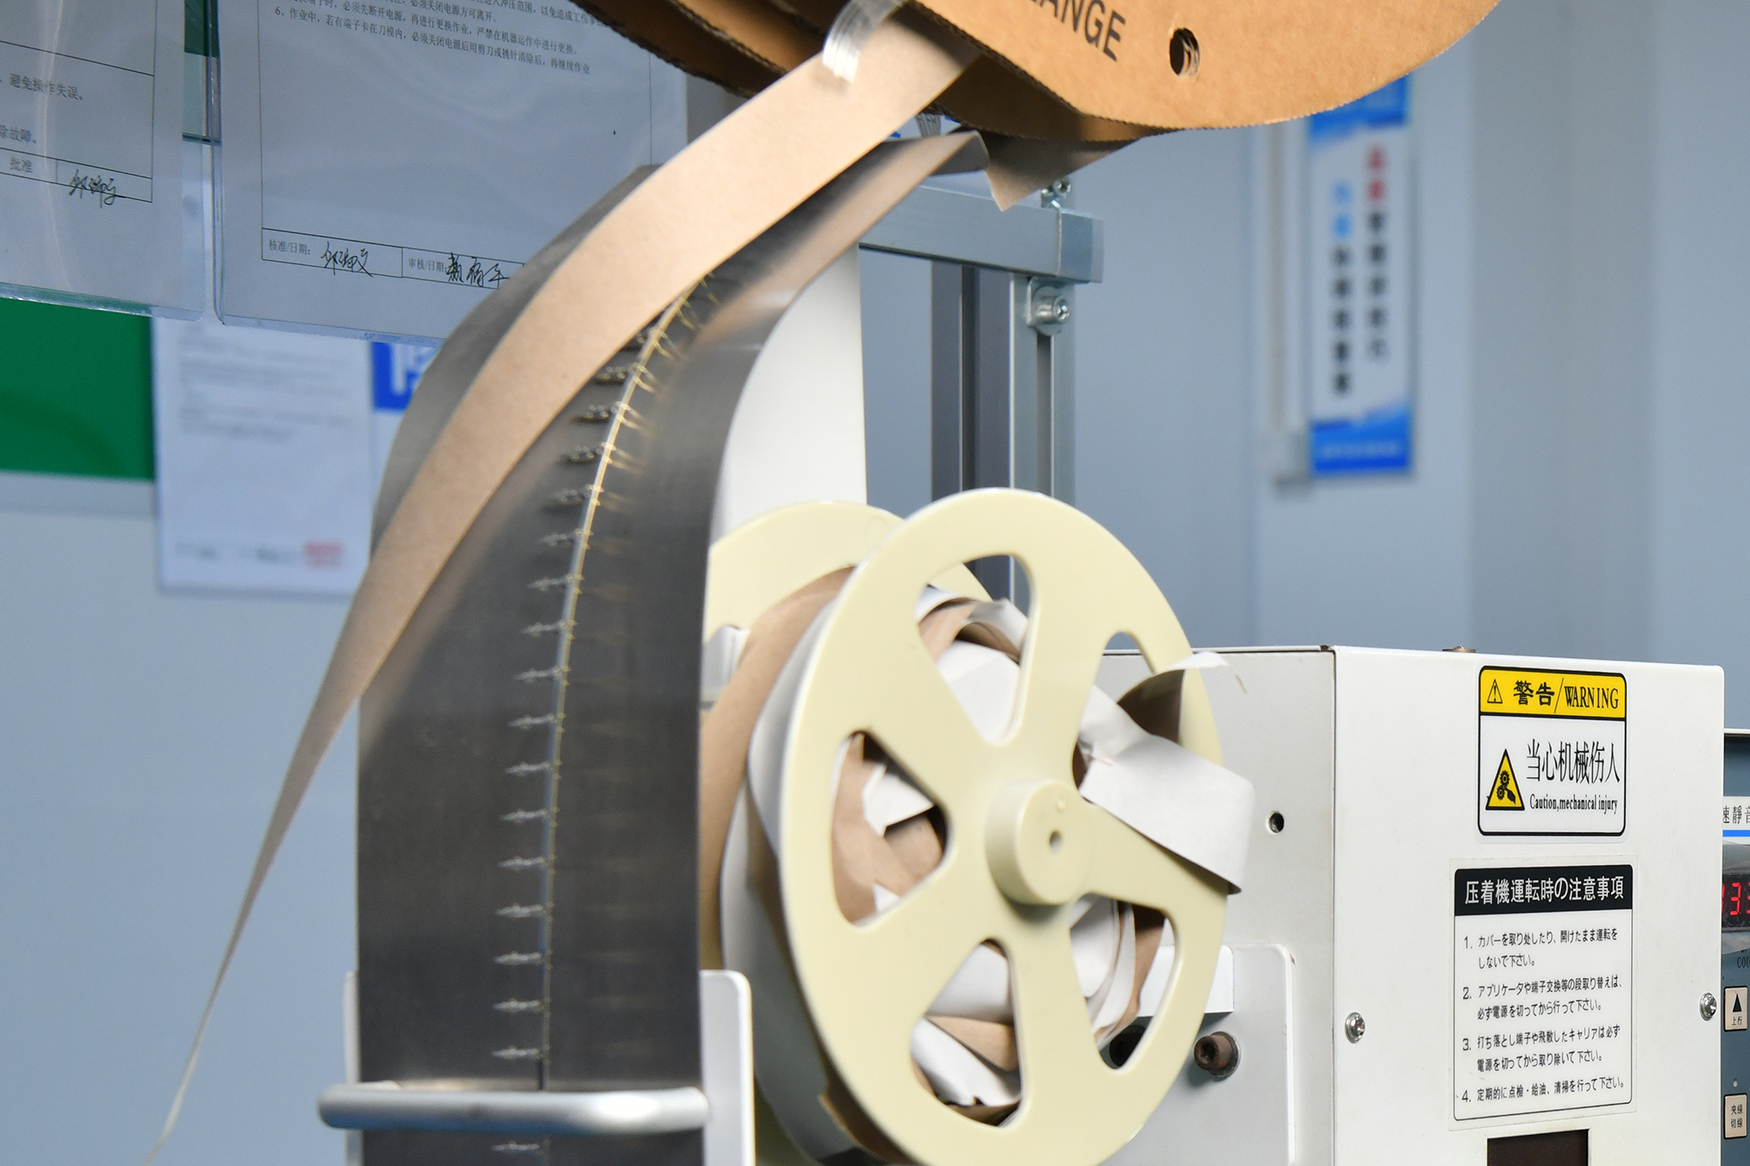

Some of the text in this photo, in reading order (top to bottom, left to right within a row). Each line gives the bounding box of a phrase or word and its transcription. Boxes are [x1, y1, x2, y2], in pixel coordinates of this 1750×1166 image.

[1526, 738, 1621, 785] 当心机械伤人
[1598, 795, 1618, 815] injury
[1478, 953, 1536, 970] しないで下さい。
